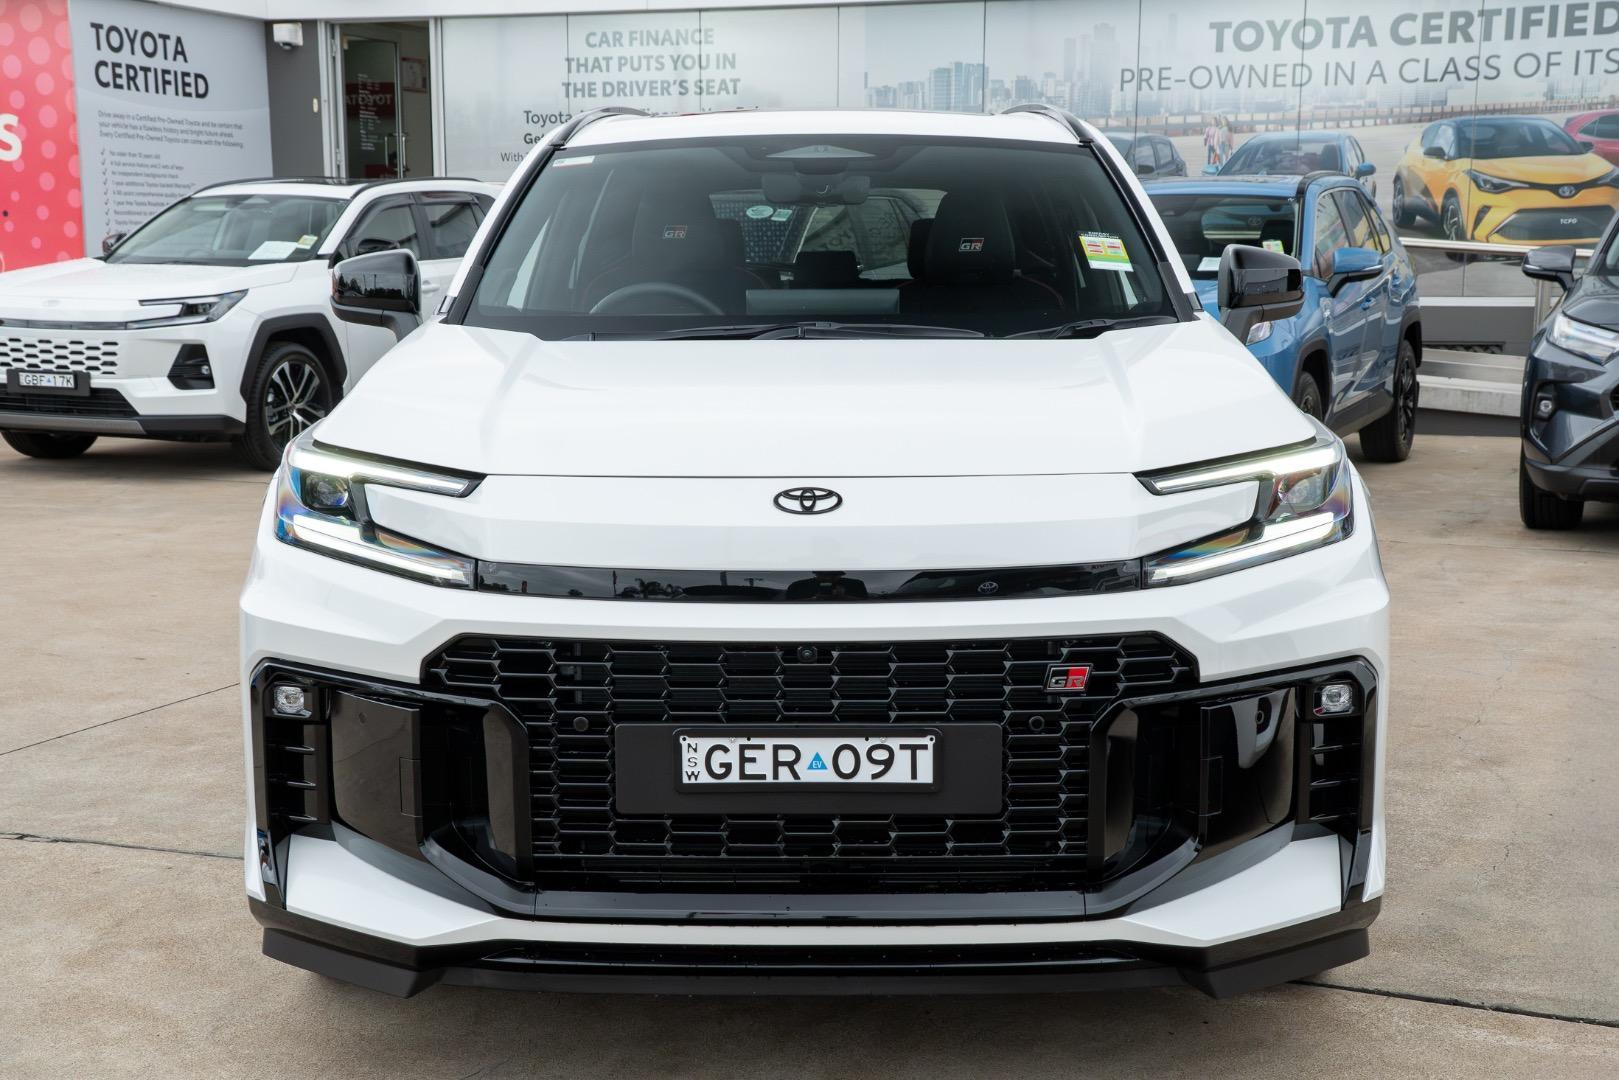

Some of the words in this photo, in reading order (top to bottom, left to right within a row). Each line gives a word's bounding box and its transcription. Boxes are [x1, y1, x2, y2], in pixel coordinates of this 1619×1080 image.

[1209, 15, 1377, 52] TOYOTA
[1389, 1, 1619, 46] CERTIFIED
[90, 22, 188, 63] TOYOTA
[585, 31, 624, 48] CAR
[628, 28, 714, 47] FINANCE
[565, 56, 613, 74] THAT
[617, 54, 665, 73] PUTS
[669, 53, 711, 71] YOU
[715, 53, 736, 70] IN
[1120, 63, 1313, 91] PRE-OWNED
[1324, 61, 1356, 86] IN
[1366, 60, 1387, 84] A
[1398, 54, 1501, 83] CLASS
[1513, 51, 1562, 78] OF
[1574, 48, 1619, 76] ITS
[94, 60, 209, 99] CERTIFIED
[562, 81, 597, 98] THE
[693, 78, 741, 96] SEAT
[524, 132, 544, 145] Ge
[500, 151, 523, 163] With
[24, 374, 45, 386] GBF
[53, 375, 73, 387] 17K
[1050, 675, 1085, 688] GR
[704, 743, 802, 781] GER
[811, 760, 823, 769] EV
[832, 743, 929, 781] 09T
